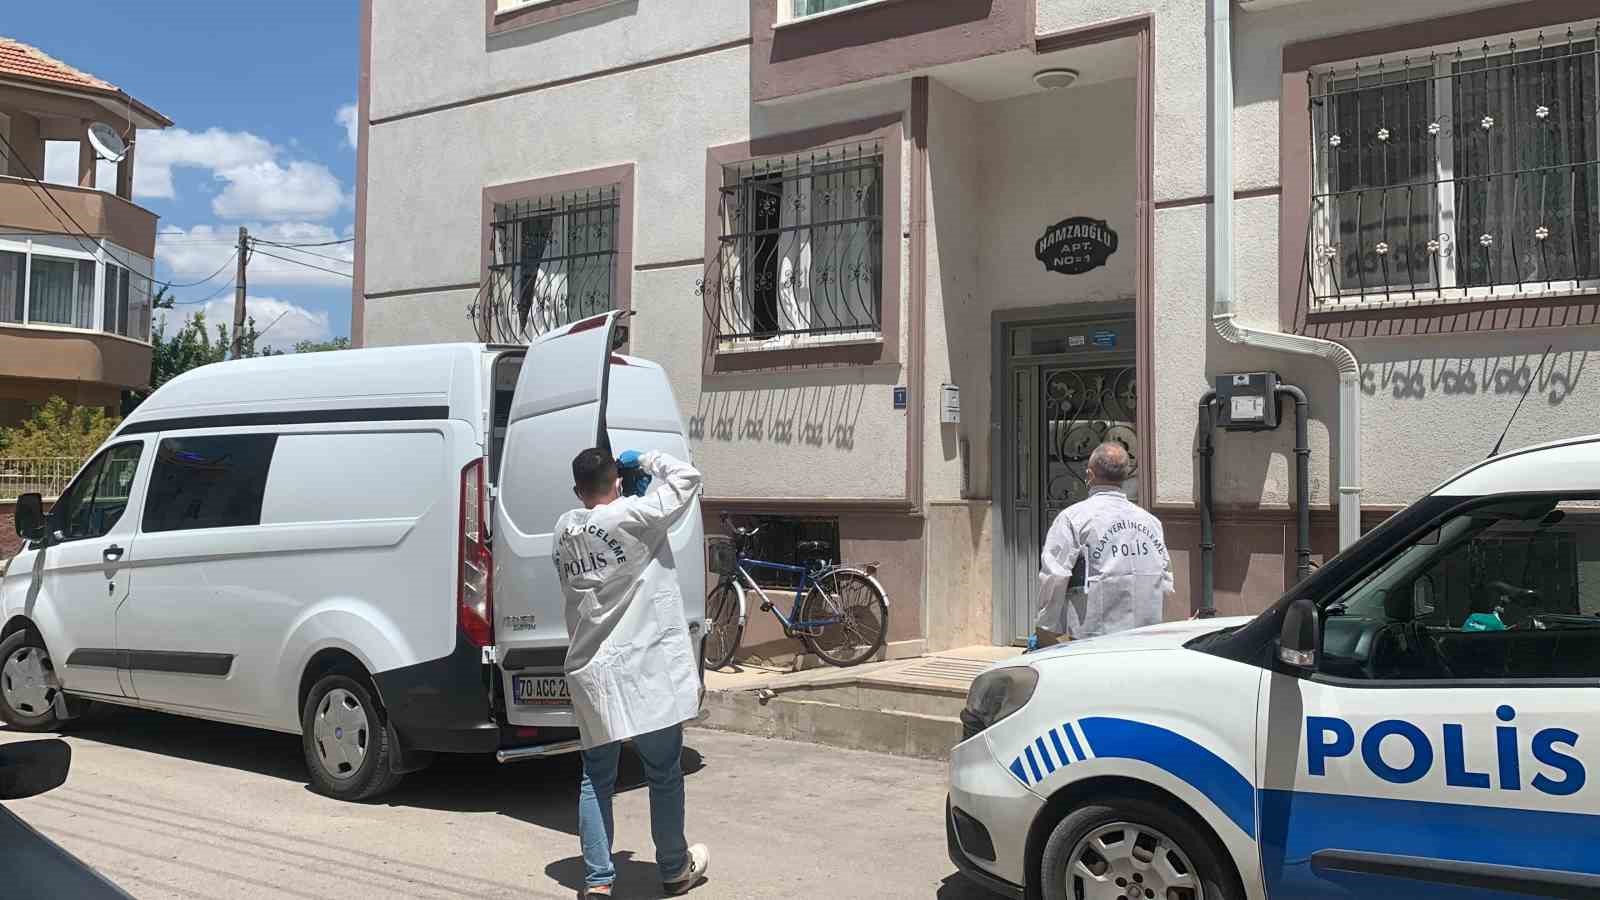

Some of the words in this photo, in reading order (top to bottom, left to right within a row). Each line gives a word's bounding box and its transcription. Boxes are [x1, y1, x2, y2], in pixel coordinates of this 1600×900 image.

[1040, 223, 1111, 253] HAMZAOĞLU
[1061, 241, 1092, 253] APT.
[577, 523, 626, 565] NCELEME
[1092, 534, 1109, 560] OLAY
[1107, 519, 1127, 536] YERİ
[1111, 538, 1149, 558] POLİS
[563, 552, 608, 579] POLİS
[520, 679, 532, 697] 70
[536, 679, 556, 698] ACC
[1306, 704, 1586, 796] POLİS
